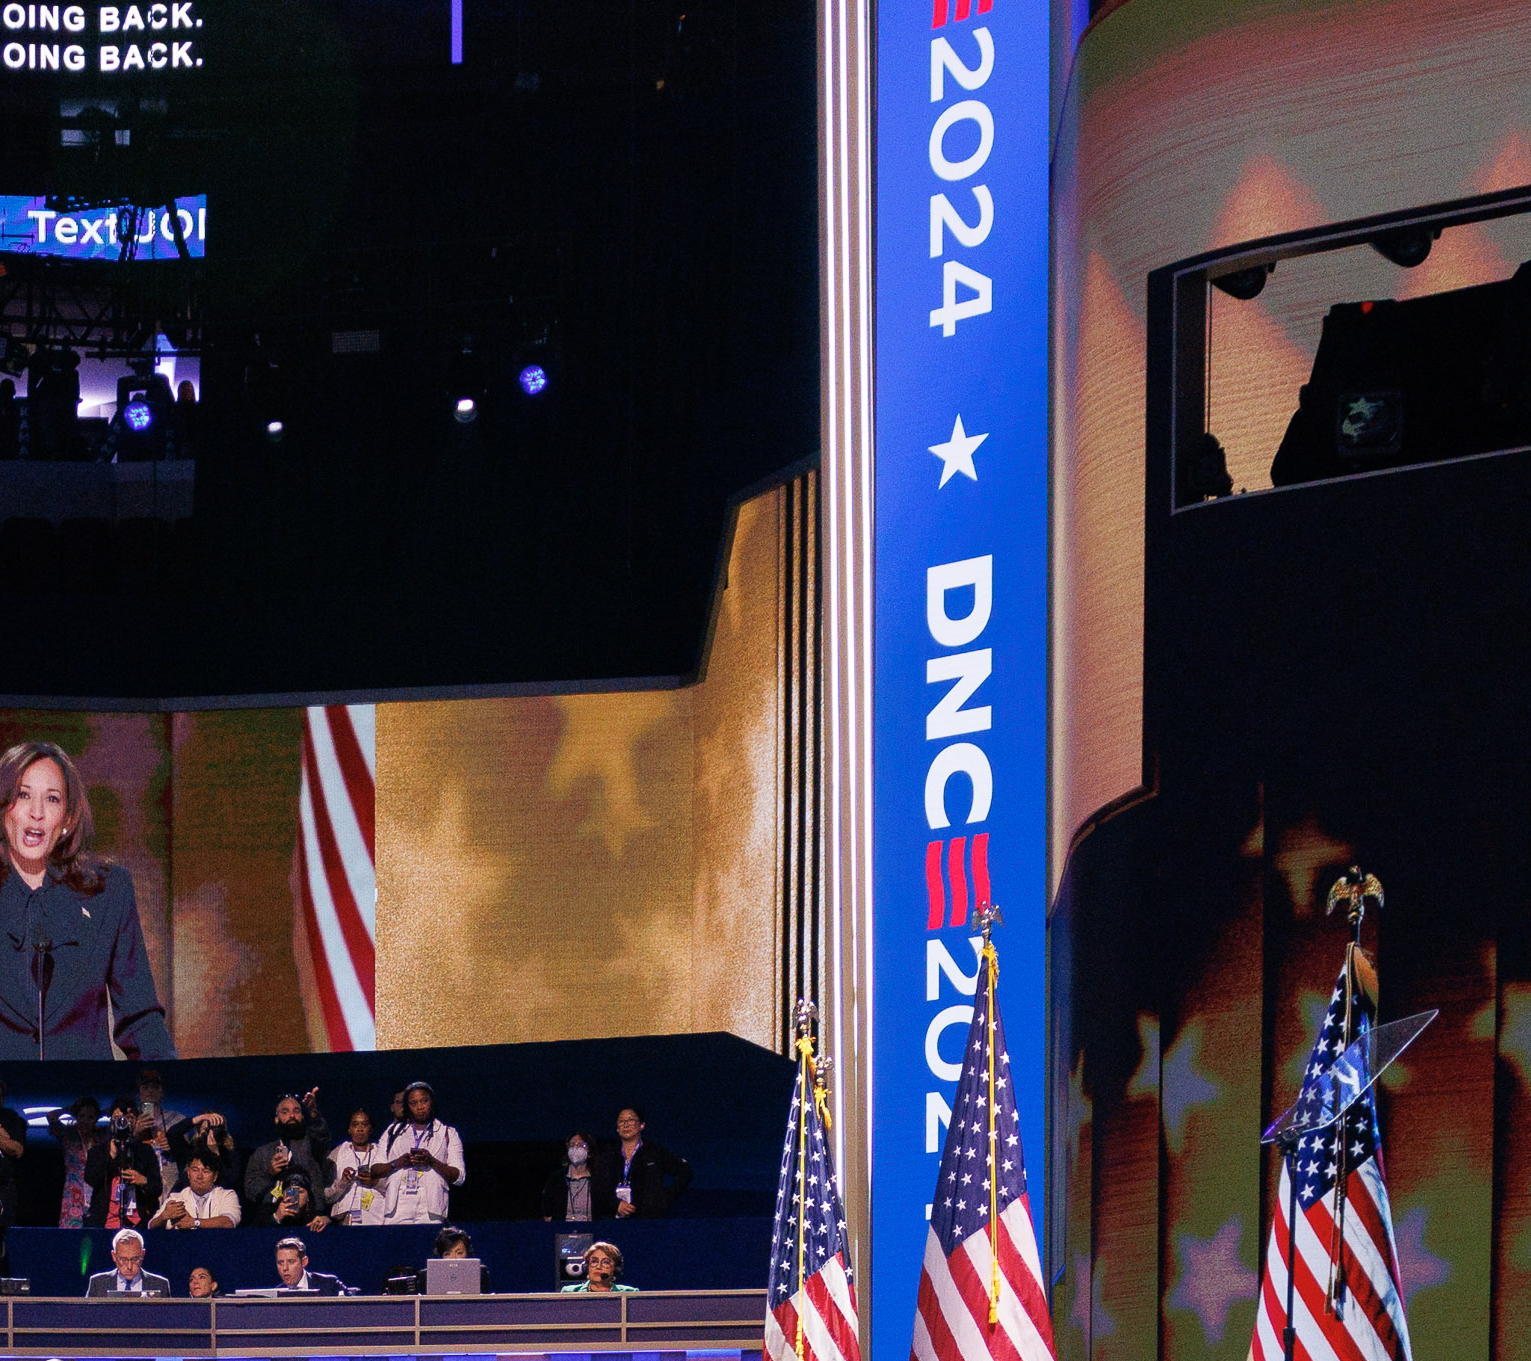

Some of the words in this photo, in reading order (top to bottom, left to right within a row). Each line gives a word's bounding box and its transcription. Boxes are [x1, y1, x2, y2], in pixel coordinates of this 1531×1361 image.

[99, 2, 203, 33] BACK.
[99, 42, 203, 72] BACK.
[28, 210, 117, 246] Text
[133, 207, 207, 245] JOI
[928, 28, 995, 338] 2024
[925, 553, 995, 828] DNC
[924, 938, 993, 1158] 20
